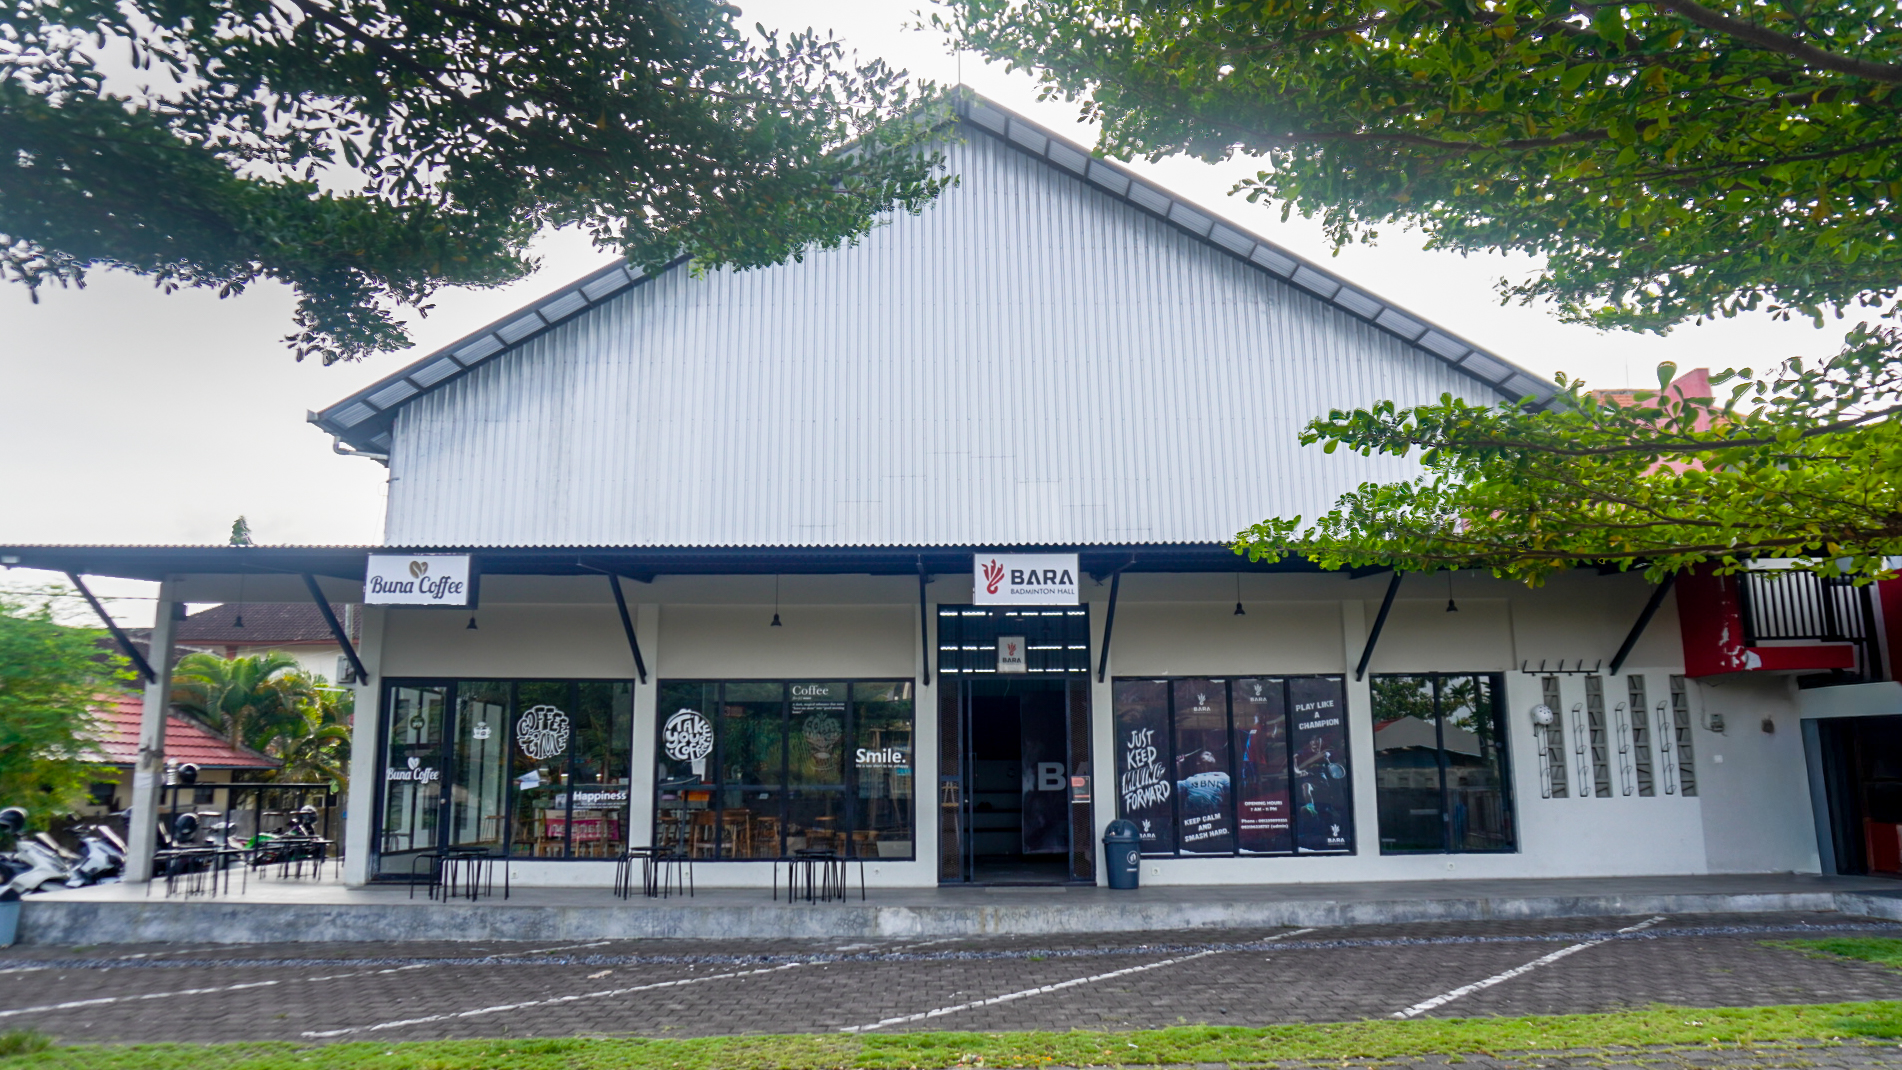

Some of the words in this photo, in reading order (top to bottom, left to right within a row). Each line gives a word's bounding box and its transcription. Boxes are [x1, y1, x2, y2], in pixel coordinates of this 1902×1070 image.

[1011, 569, 1074, 585] BARA
[370, 575, 414, 594] Buna
[418, 575, 463, 599] Coffee
[792, 685, 829, 696] Coffee
[1295, 702, 1315, 712] PLAY
[1316, 700, 1334, 709] LIKE
[517, 705, 570, 737] COFFEE
[1314, 711, 1320, 719] A
[1298, 718, 1339, 731] CHAMPION
[1127, 728, 1155, 749] JUST
[855, 748, 906, 763] Smile.
[1127, 746, 1157, 772] KEEP
[386, 767, 412, 781] Buna
[413, 767, 440, 784] Coffee
[573, 790, 627, 803] Happiness
[1124, 780, 1171, 814] FORWARD
[1184, 816, 1201, 827] KEEP
[1202, 812, 1222, 823] CALM
[1198, 823, 1212, 832] AND
[1184, 832, 1209, 843] SMASH
